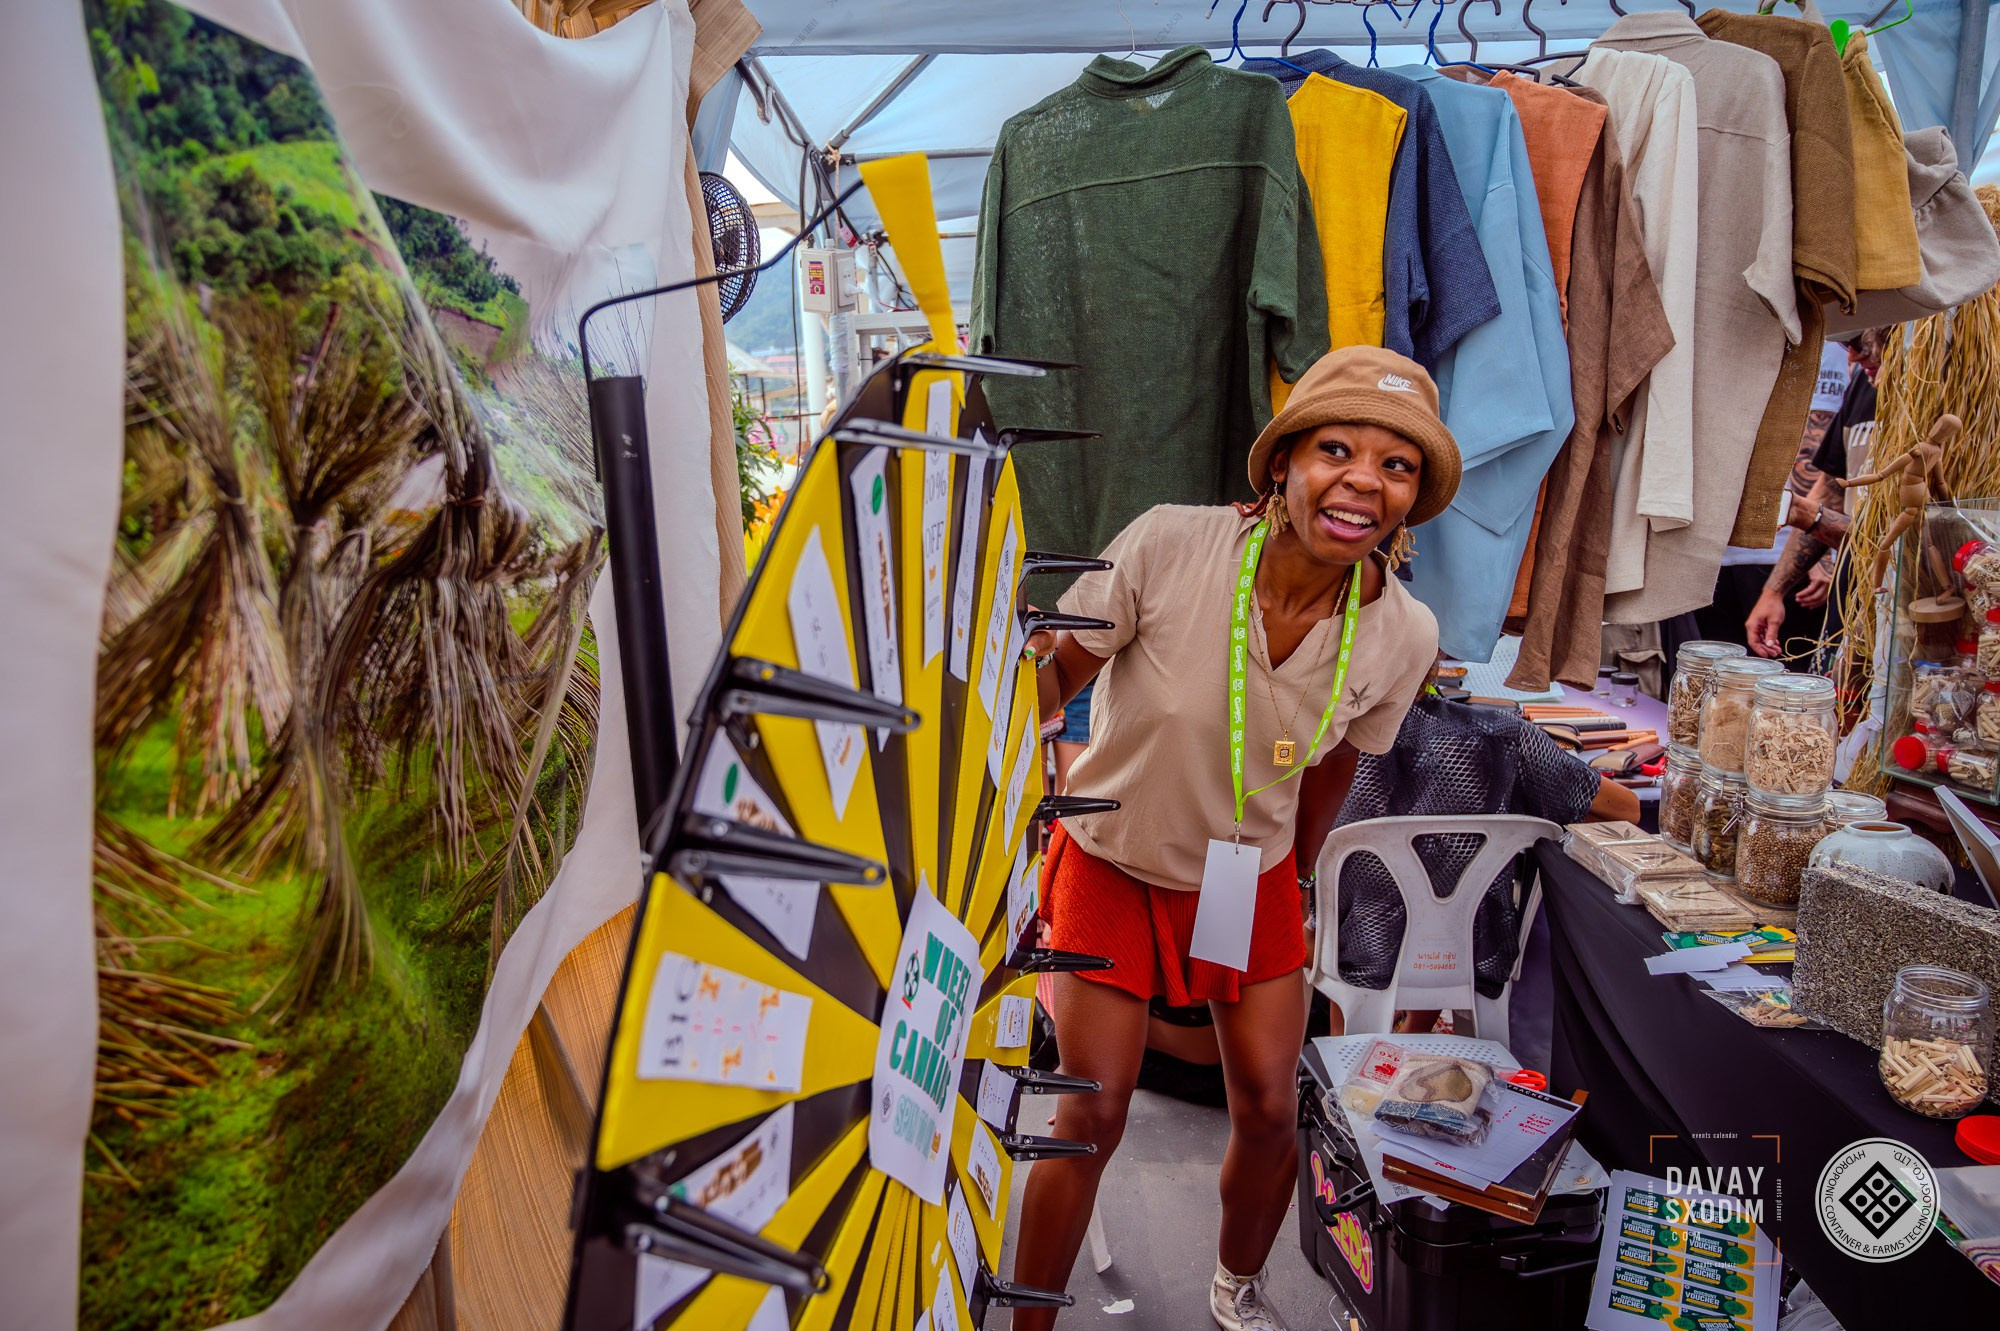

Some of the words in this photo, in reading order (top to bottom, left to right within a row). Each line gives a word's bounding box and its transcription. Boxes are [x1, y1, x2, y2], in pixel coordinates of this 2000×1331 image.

[1383, 373, 1412, 388] NIKE
[922, 930, 971, 1017] WHEEL
[934, 999, 957, 1051] OF
[1627, 1195, 1659, 1209] VOUCHER
[1623, 1222, 1656, 1237] VOUCHER
[1689, 1239, 1723, 1253] VOUCHER
[1616, 1273, 1650, 1287] VOUCHER
[1687, 1267, 1721, 1281] VOUCHER
[1612, 1296, 1646, 1310] VOUCHER
[1685, 1291, 1720, 1306] VOUCHER
